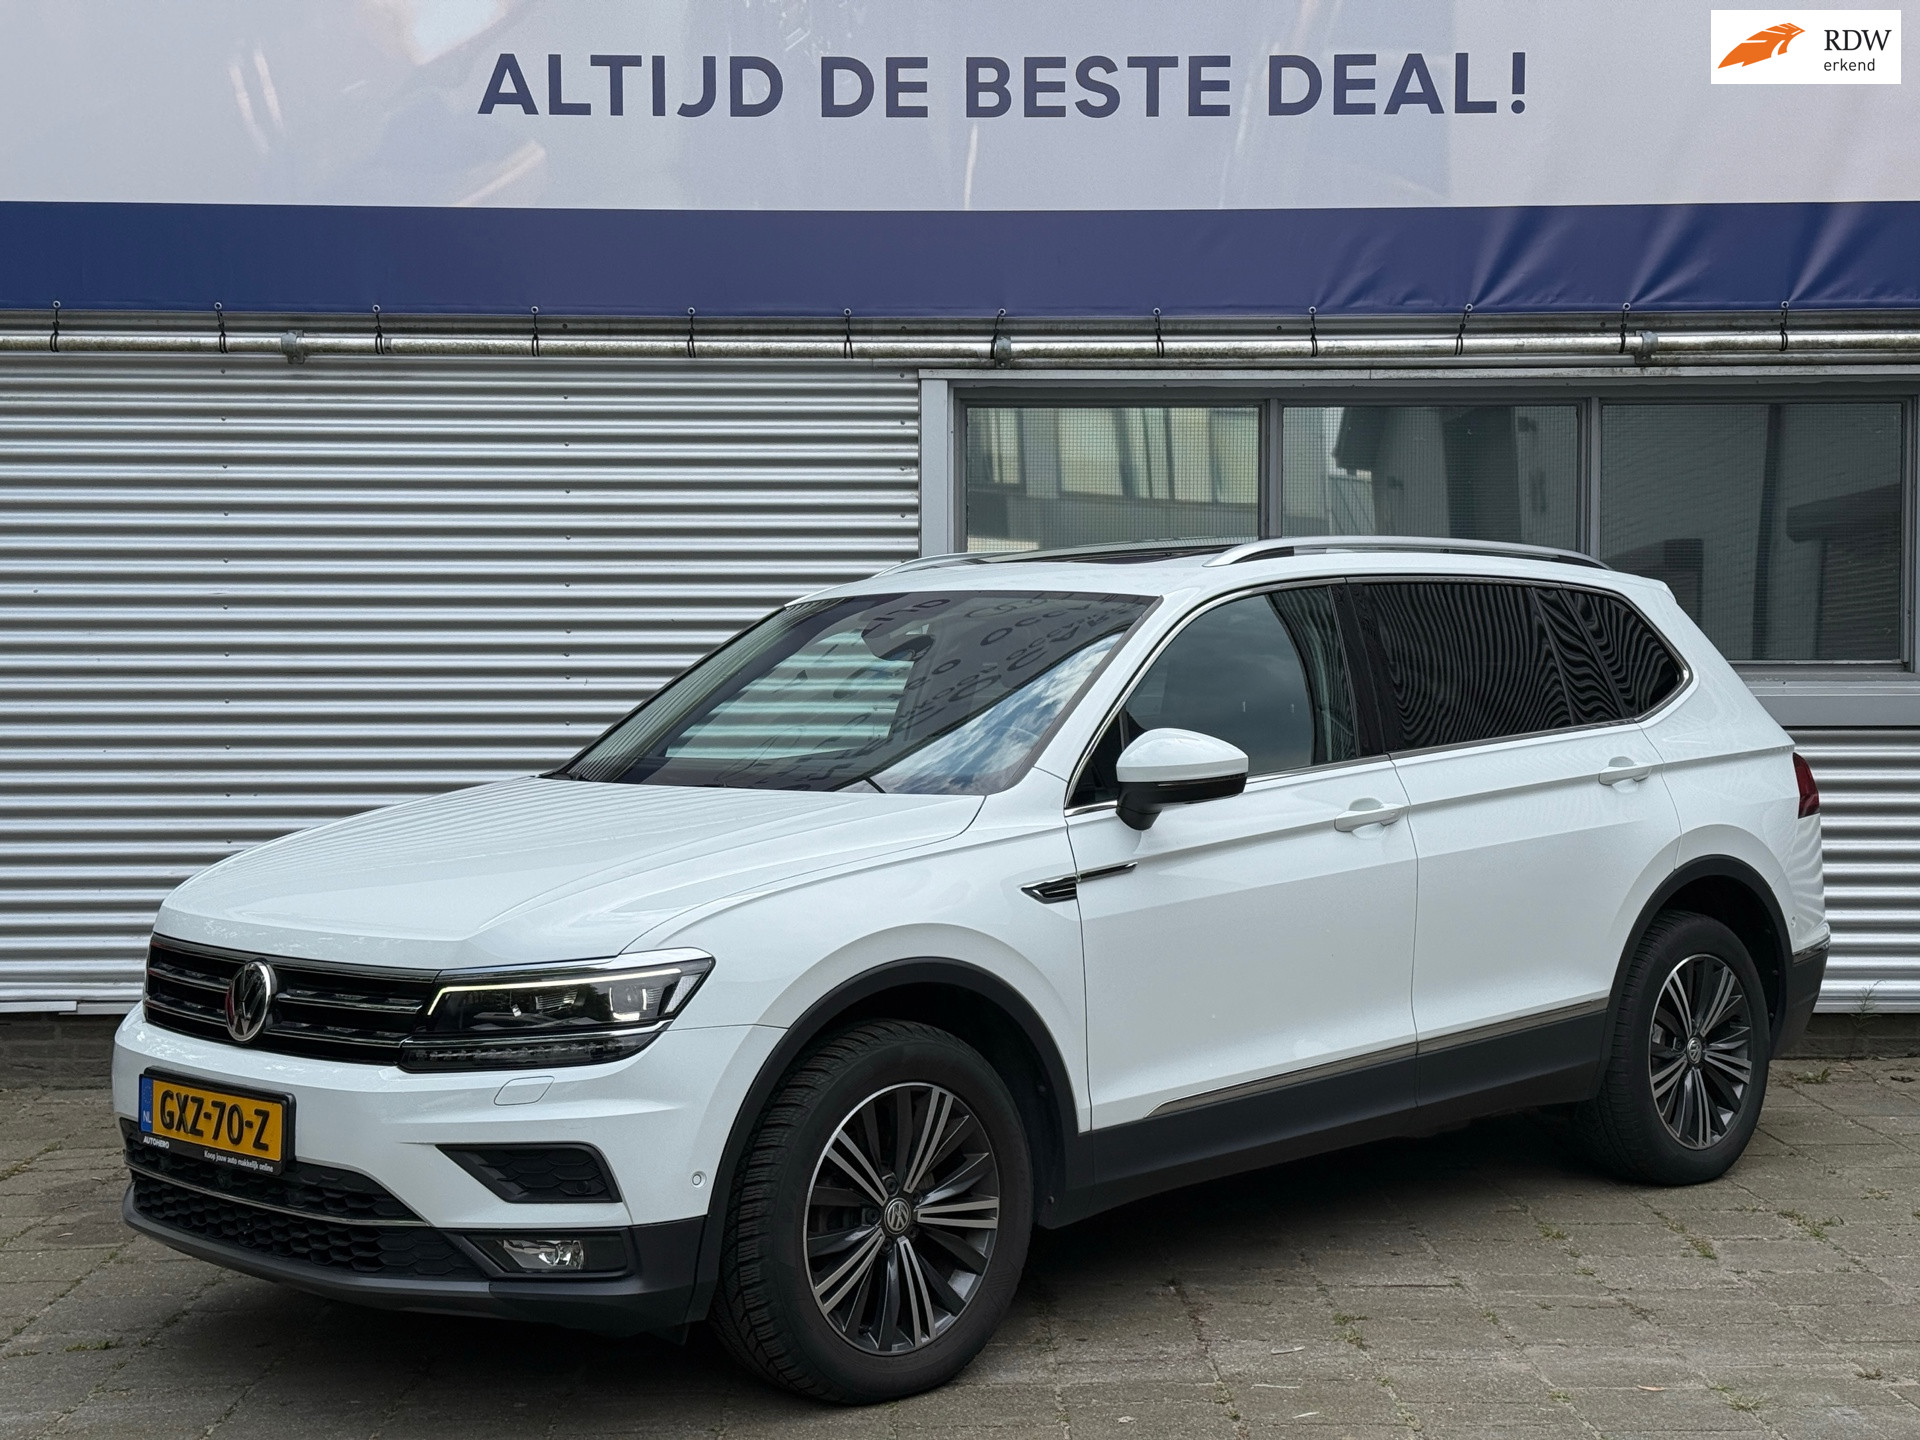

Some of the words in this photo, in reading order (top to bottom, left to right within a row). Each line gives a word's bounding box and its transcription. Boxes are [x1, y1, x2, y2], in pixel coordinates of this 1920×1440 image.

[478, 53, 784, 118] ALTIJD
[820, 56, 929, 118] DE
[965, 55, 1232, 118] BESTE
[1268, 52, 1527, 116] DEAL!
[142, 1110, 152, 1124] NL
[160, 1089, 270, 1151] GXZ-70-Z
[143, 1135, 169, 1148] AUTOHERO
[204, 1150, 216, 1161] Koop
[216, 1153, 227, 1162] jouw
[227, 1156, 238, 1165] auto
[238, 1159, 259, 1170] makkelijk
[259, 1163, 274, 1172] online
